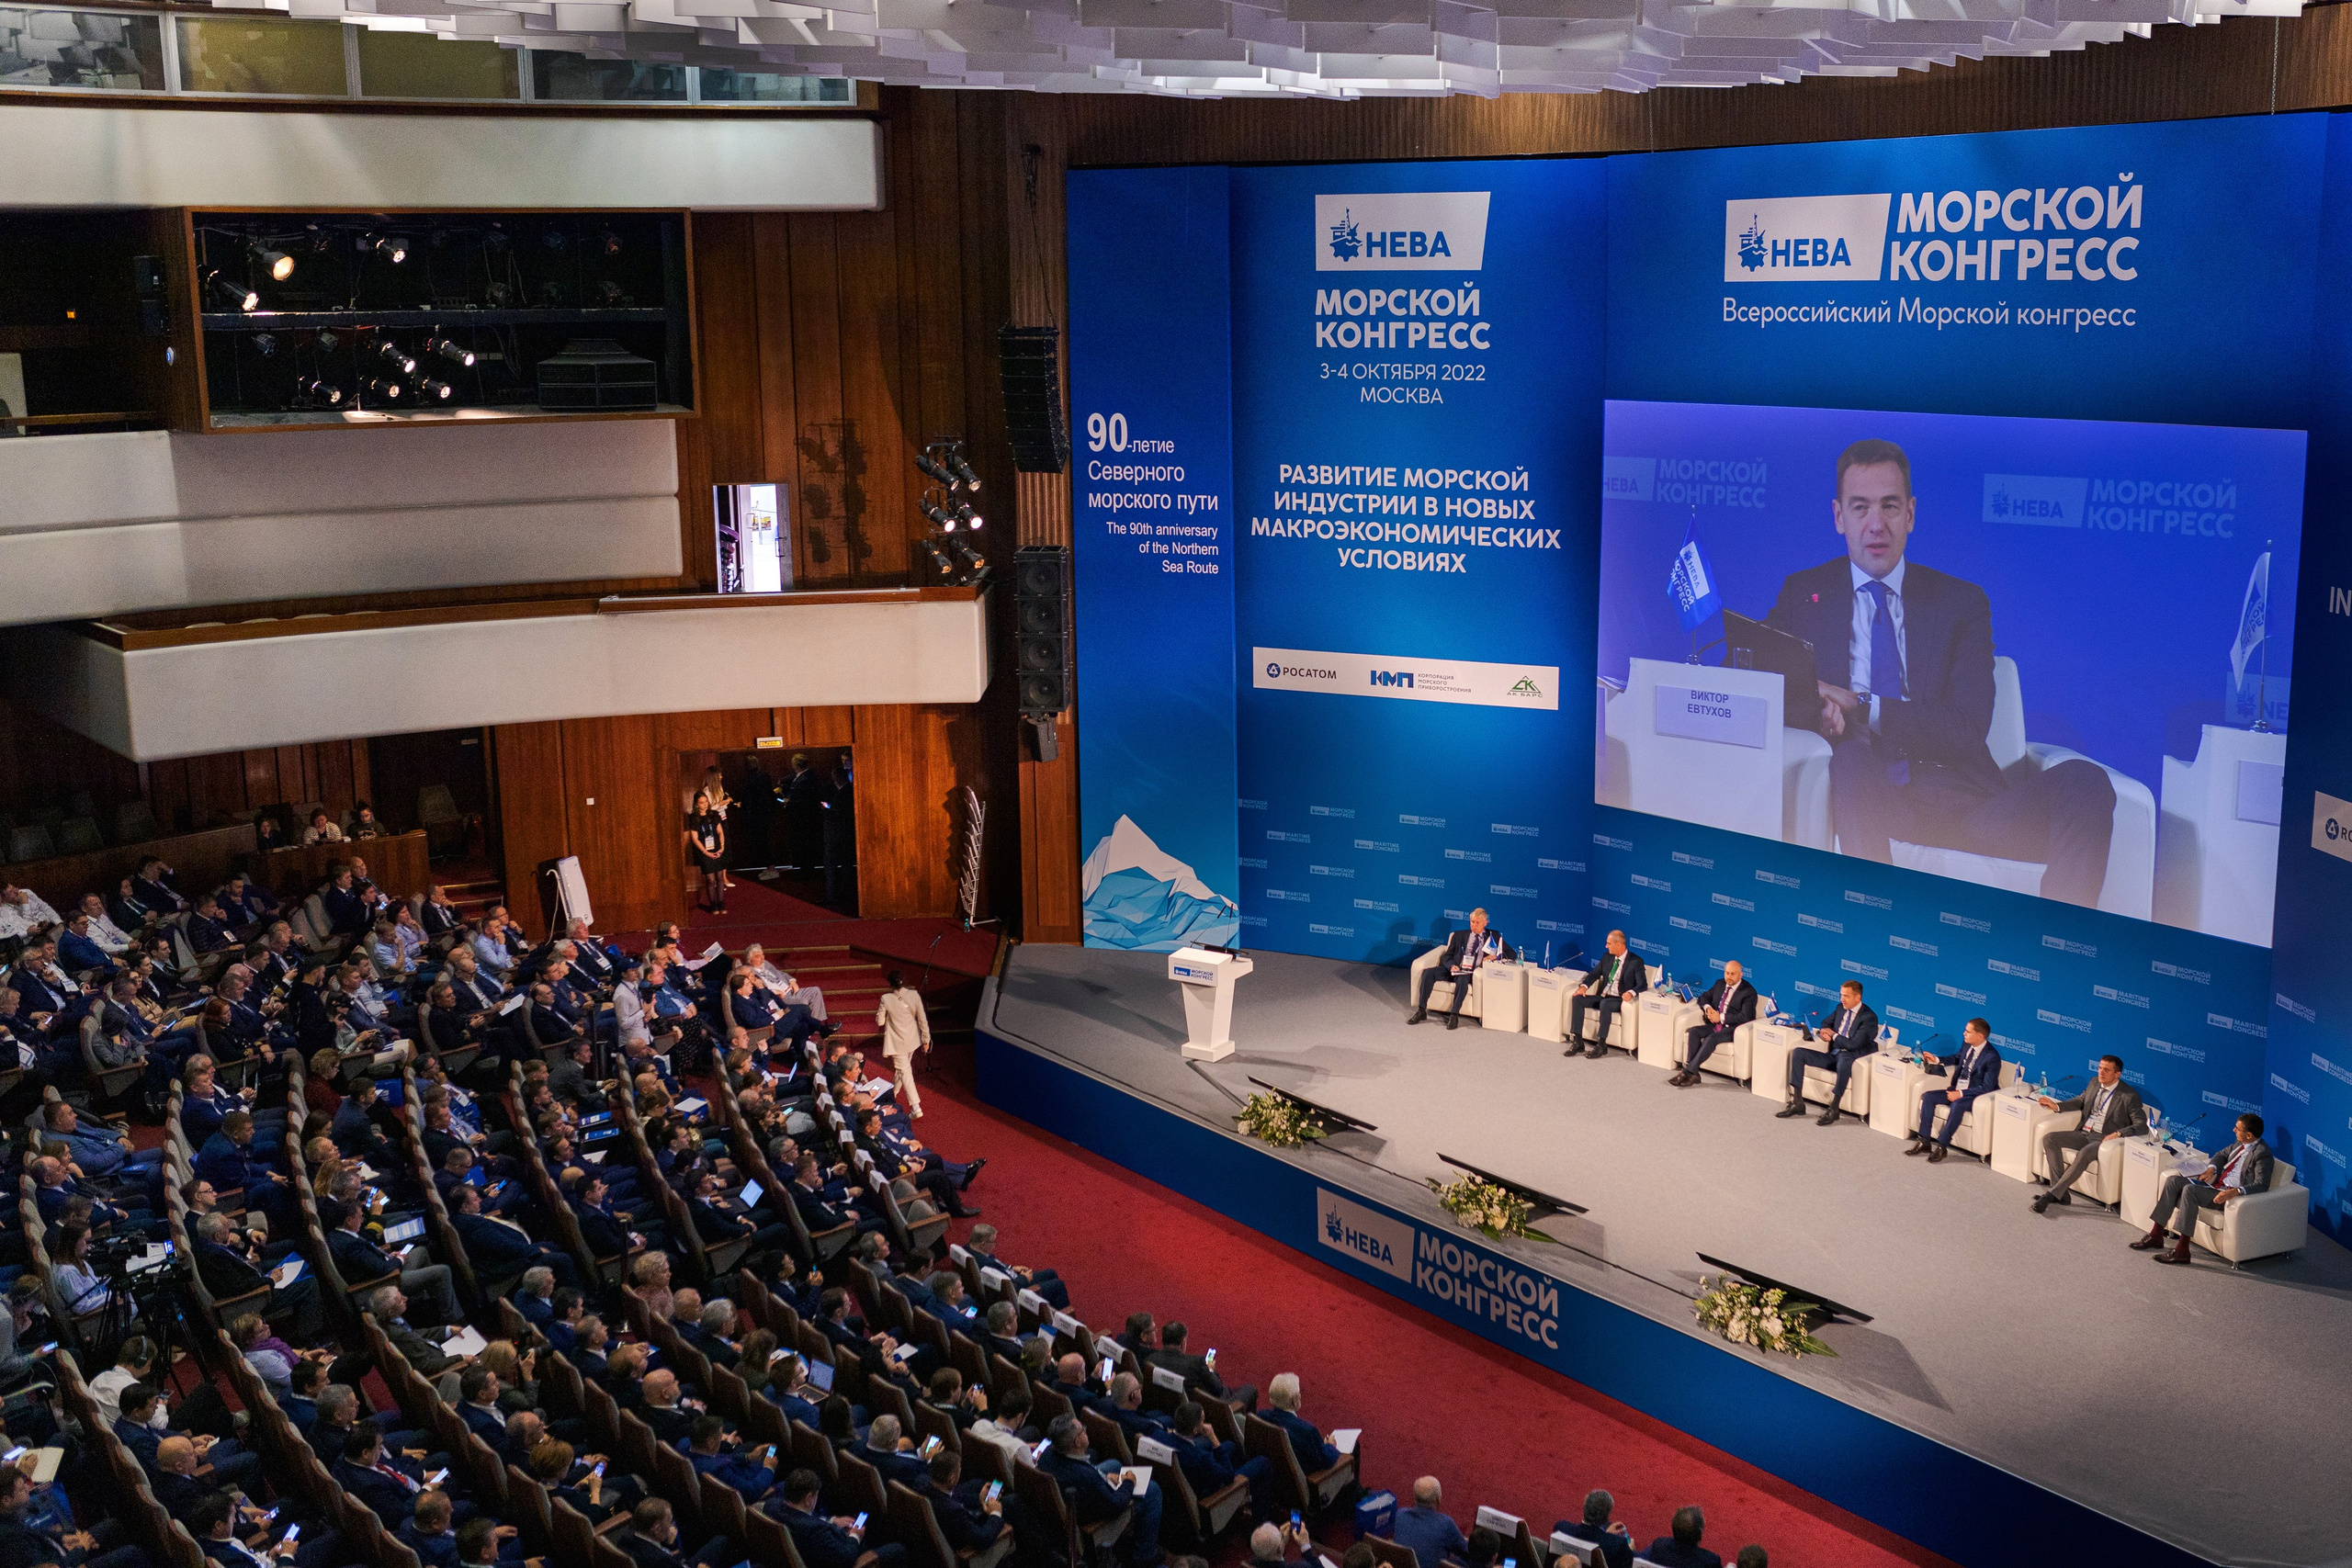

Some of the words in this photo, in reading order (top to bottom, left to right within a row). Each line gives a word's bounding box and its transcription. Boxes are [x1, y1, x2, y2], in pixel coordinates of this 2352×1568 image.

[1896, 173, 2143, 232] МОРСКОЙ
[1366, 231, 1452, 258] НЕВА
[1771, 238, 1851, 267] НЕВА
[1890, 237, 2140, 281] КОНГРЕСС
[1316, 281, 1481, 316] МОРСКОЙ
[1723, 297, 1892, 328] Всероссийский
[1898, 297, 2009, 331] Морской
[2017, 300, 2136, 333] конгресс
[1316, 322, 1491, 350] КОНГРЕСС
[1319, 364, 1349, 379] 3-4
[1352, 364, 1437, 380] ОКТЯБРЯ
[1442, 365, 1486, 381] 2022
[1360, 387, 1443, 404] МОСКВА
[1089, 460, 1184, 485] Северного
[1279, 464, 1397, 487] РАЗВИТИЕ
[1403, 467, 1530, 491] МОРСКОЙ
[1660, 457, 1768, 484] МОРСКОЙ
[1657, 483, 1766, 508] КОНГРЕСС
[2092, 478, 2237, 509] МОРСКОЙ
[1089, 492, 1171, 513] морского
[1178, 494, 1218, 515] пути
[1273, 491, 1417, 516] ИНДУСТРИИ
[1424, 496, 1439, 516] В
[1445, 499, 1536, 521] НОВЫХ
[2013, 499, 2064, 519] НЕВА
[2087, 506, 2234, 538] КОНГРЕСС
[1106, 522, 1126, 535] The
[1130, 523, 1153, 535] 90th
[1156, 524, 1218, 539] anniversary
[1250, 518, 1562, 549] МАКРОЭКОНОМИЧЕСКИХ
[1139, 541, 1149, 553] of
[1152, 542, 1169, 554] the
[1172, 542, 1218, 556] Northern
[1162, 560, 1183, 572] Sea
[1187, 560, 1218, 574] Route
[1338, 547, 1466, 574] УСЛОВИЯХ
[1688, 561, 1700, 589] НЕВА
[1283, 668, 1337, 680] РОСАТОМ
[1371, 671, 1414, 688] КМП
[1690, 691, 1729, 704] ВИКТОР
[1688, 704, 1732, 718] ЕВТУХОВ
[1510, 891, 1538, 899] КОНГРЕСС
[1865, 896, 1893, 906] МОРСКОЙ
[1865, 899, 1892, 910] КОНГРЕСС
[1817, 919, 1844, 929] MARITIME
[1817, 923, 1844, 934] CONGRESS
[1962, 917, 1991, 928] МОРСКОЙ
[1962, 921, 1991, 933] КОНГРЕСС
[1910, 945, 1939, 957] CONGRESS
[1911, 941, 1939, 951] MARITIME
[2065, 945, 2097, 958] КОНГРЕСС
[2066, 941, 2098, 953] МОРСКОЙ
[1860, 969, 1888, 981] КОНГРЕСС
[1861, 964, 1889, 976] МОРСКОЙ
[2010, 969, 2041, 982] CONGRESS
[2011, 964, 2041, 976] MARITIME
[2178, 966, 2211, 979] МОРСКОЙ
[2177, 972, 2211, 986] КОНГРЕСС
[1815, 987, 1840, 997] MARITIME
[1958, 988, 1986, 1001] МОРСКОЙ
[2119, 990, 2150, 1003] MARITIME
[1957, 994, 1986, 1006] КОНГРЕСС
[2118, 996, 2150, 1009] CONGRESS
[1906, 1016, 1935, 1028] CONGRESS
[1907, 1011, 1935, 1022] MARITIME
[2061, 1015, 2092, 1028] МОРСКОЙ
[2061, 1021, 2091, 1033] КОНГРЕСС
[2233, 1025, 2267, 1039] CONGRESS
[2234, 1019, 2267, 1032] MARITIME
[2006, 1043, 2036, 1055] CONGRESS
[2007, 1037, 2036, 1050] MARITIME
[2173, 1043, 2206, 1057] МОРСКОЙ
[2172, 1050, 2205, 1064] КОНГРЕСС
[2288, 1089, 2310, 1105] КОНГРЕСС
[2289, 1082, 2311, 1098] МОРСКОЙ
[2229, 1098, 2263, 1111] MARITIME
[2323, 1150, 2346, 1168] CONGRESS
[2324, 1144, 2346, 1162] MARITIME
[1346, 1226, 1394, 1267] НЕВА
[1419, 1231, 1558, 1318] МОРСКОЙ
[1417, 1261, 1558, 1350] КОНГРЕСС
